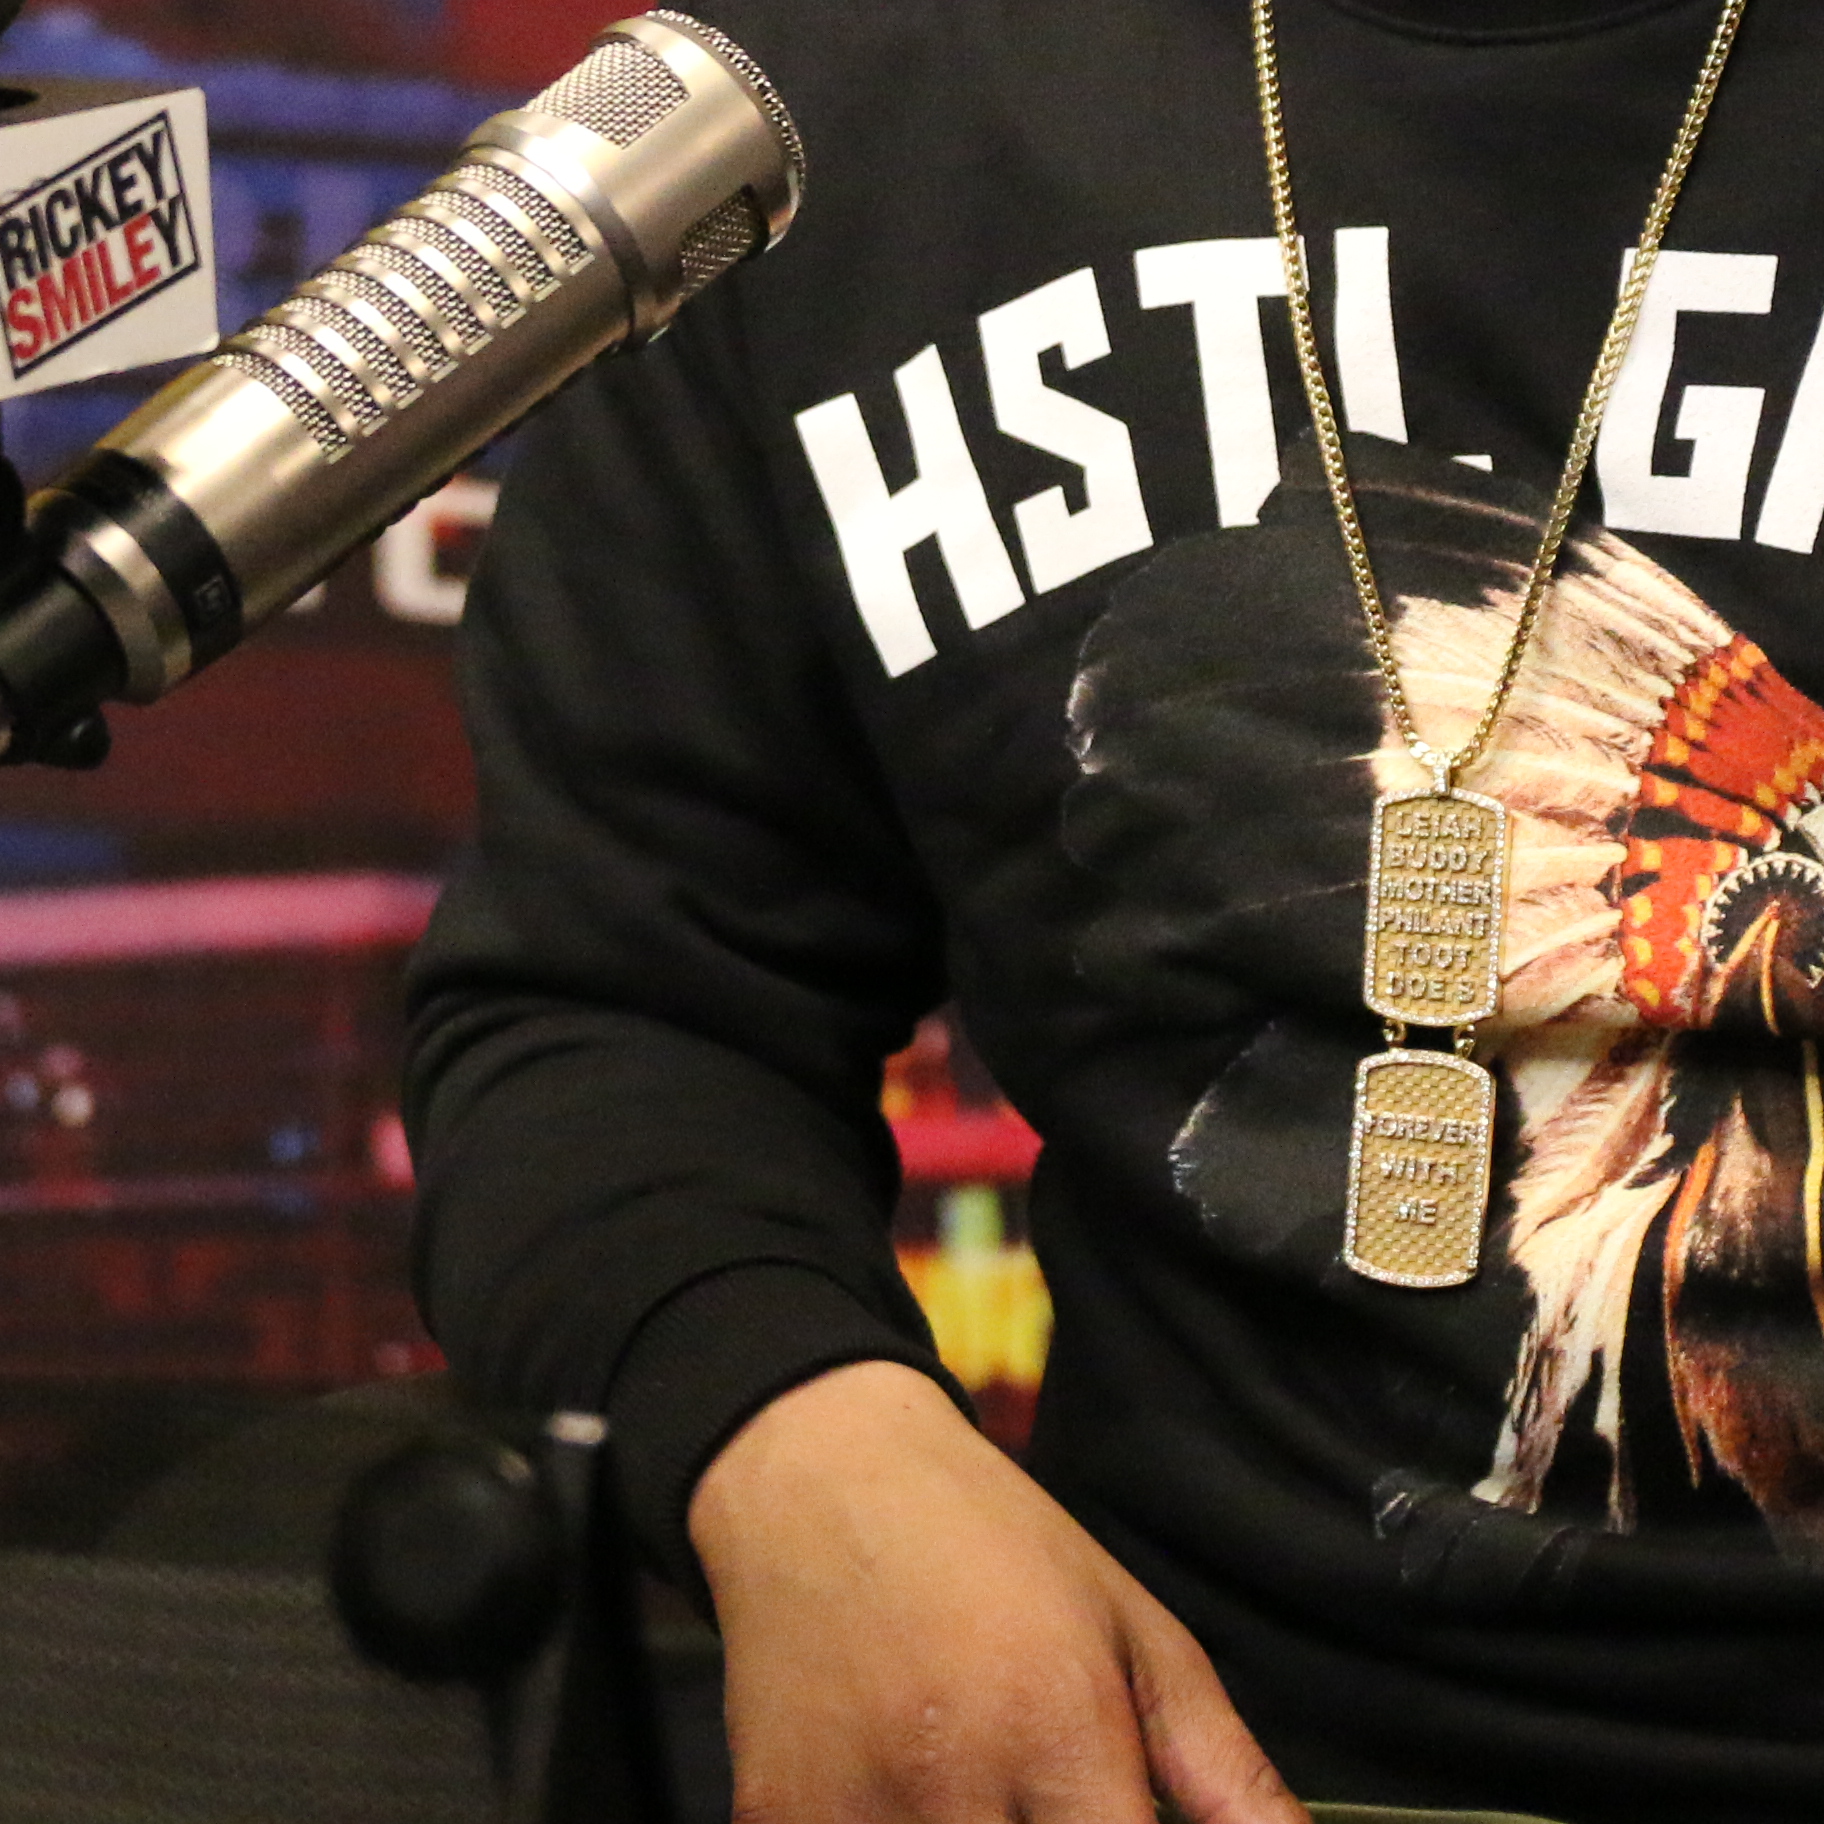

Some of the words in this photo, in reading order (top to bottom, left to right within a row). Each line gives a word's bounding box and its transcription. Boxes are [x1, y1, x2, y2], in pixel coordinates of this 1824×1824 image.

[7, 193, 186, 362] SMILEY
[1385, 843, 1488, 871] BUDDY
[1379, 875, 1492, 905] MOTHER
[1393, 940, 1473, 970] TOOT
[1363, 1111, 1478, 1145] FOREVER
[1379, 1152, 1459, 1186] WITH
[1397, 1197, 1438, 1226] ME
